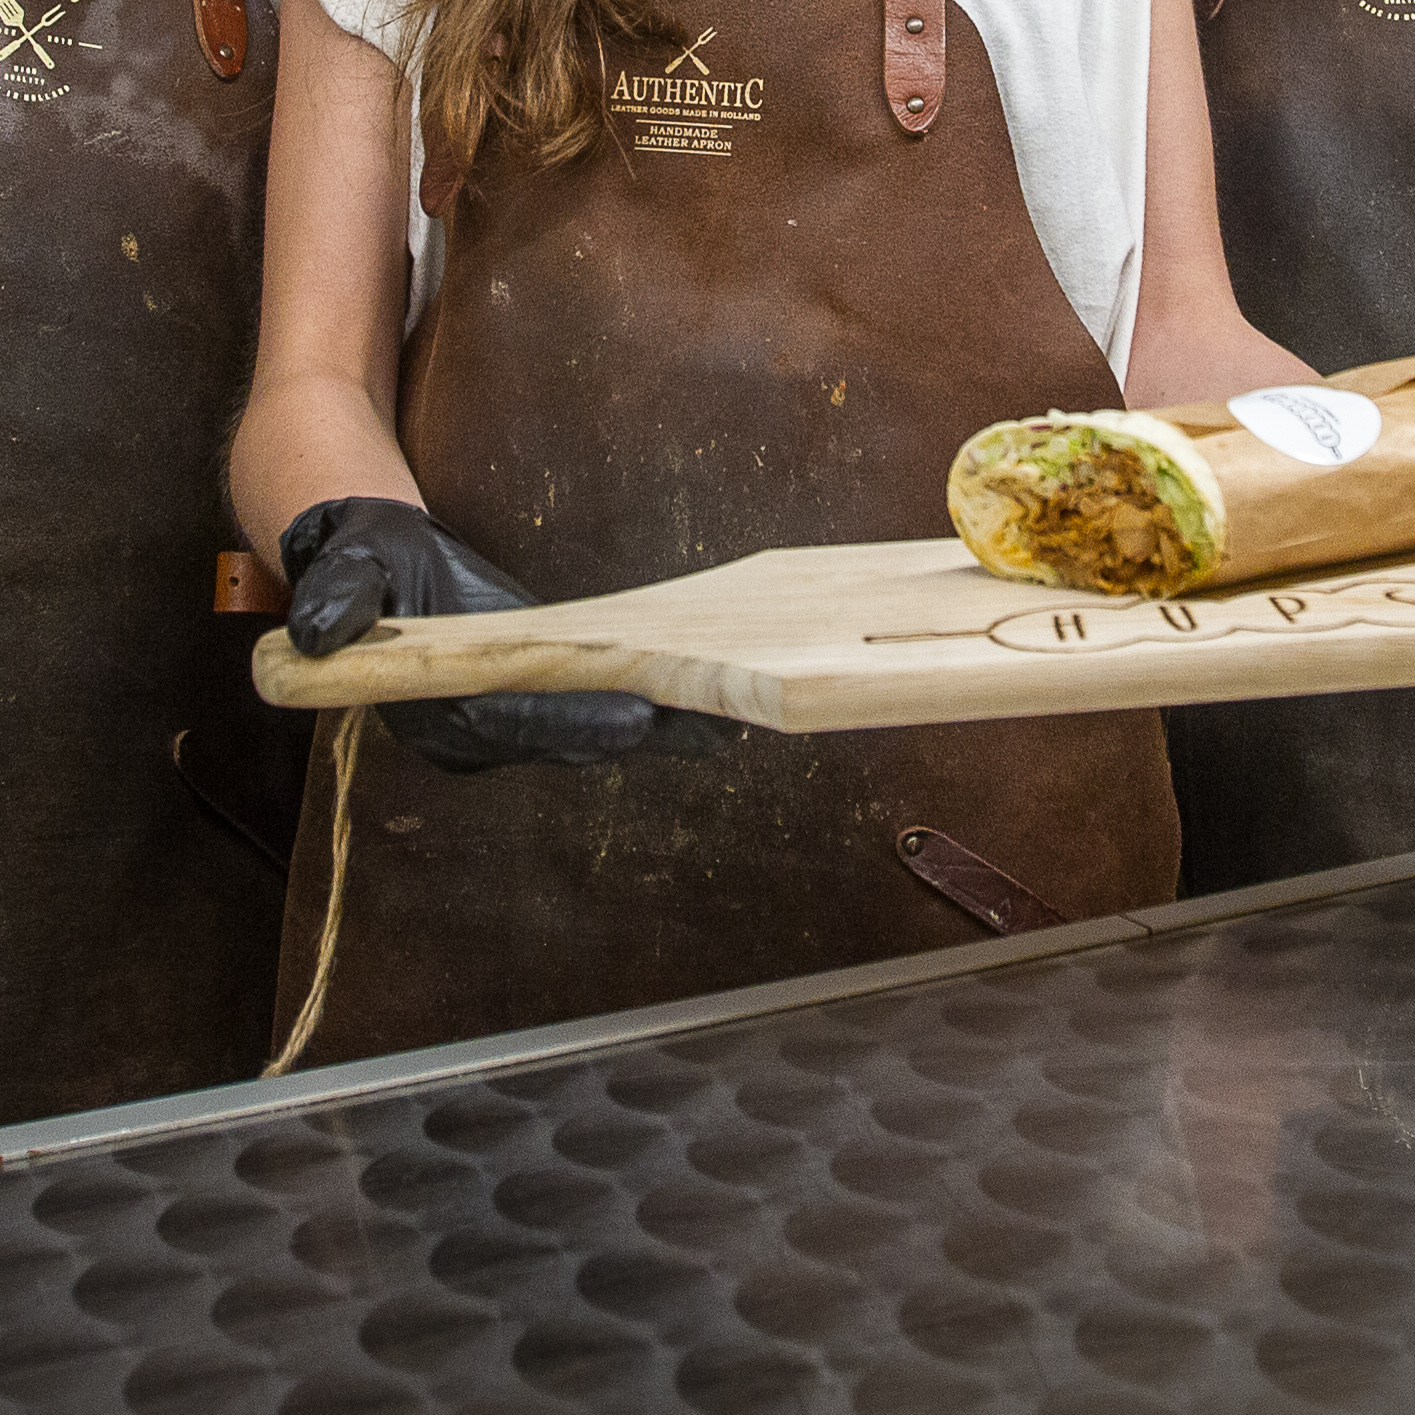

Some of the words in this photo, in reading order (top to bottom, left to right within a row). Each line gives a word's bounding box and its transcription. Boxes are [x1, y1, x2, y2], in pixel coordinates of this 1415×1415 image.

[1358, 0, 1384, 17] MADE
[4, 73, 45, 86] QUALITY
[6, 90, 19, 100] IN
[23, 84, 70, 102] HOLLAND
[611, 70, 764, 109] AUTHENTIC
[611, 104, 648, 114] LEATHER
[650, 106, 680, 116] GOODS
[682, 108, 707, 118] MADE
[709, 110, 719, 118] IN
[720, 111, 762, 121] HOLLAND
[650, 125, 718, 139] HANDMADE
[635, 135, 689, 148] LEATHER
[691, 138, 732, 151] APRON
